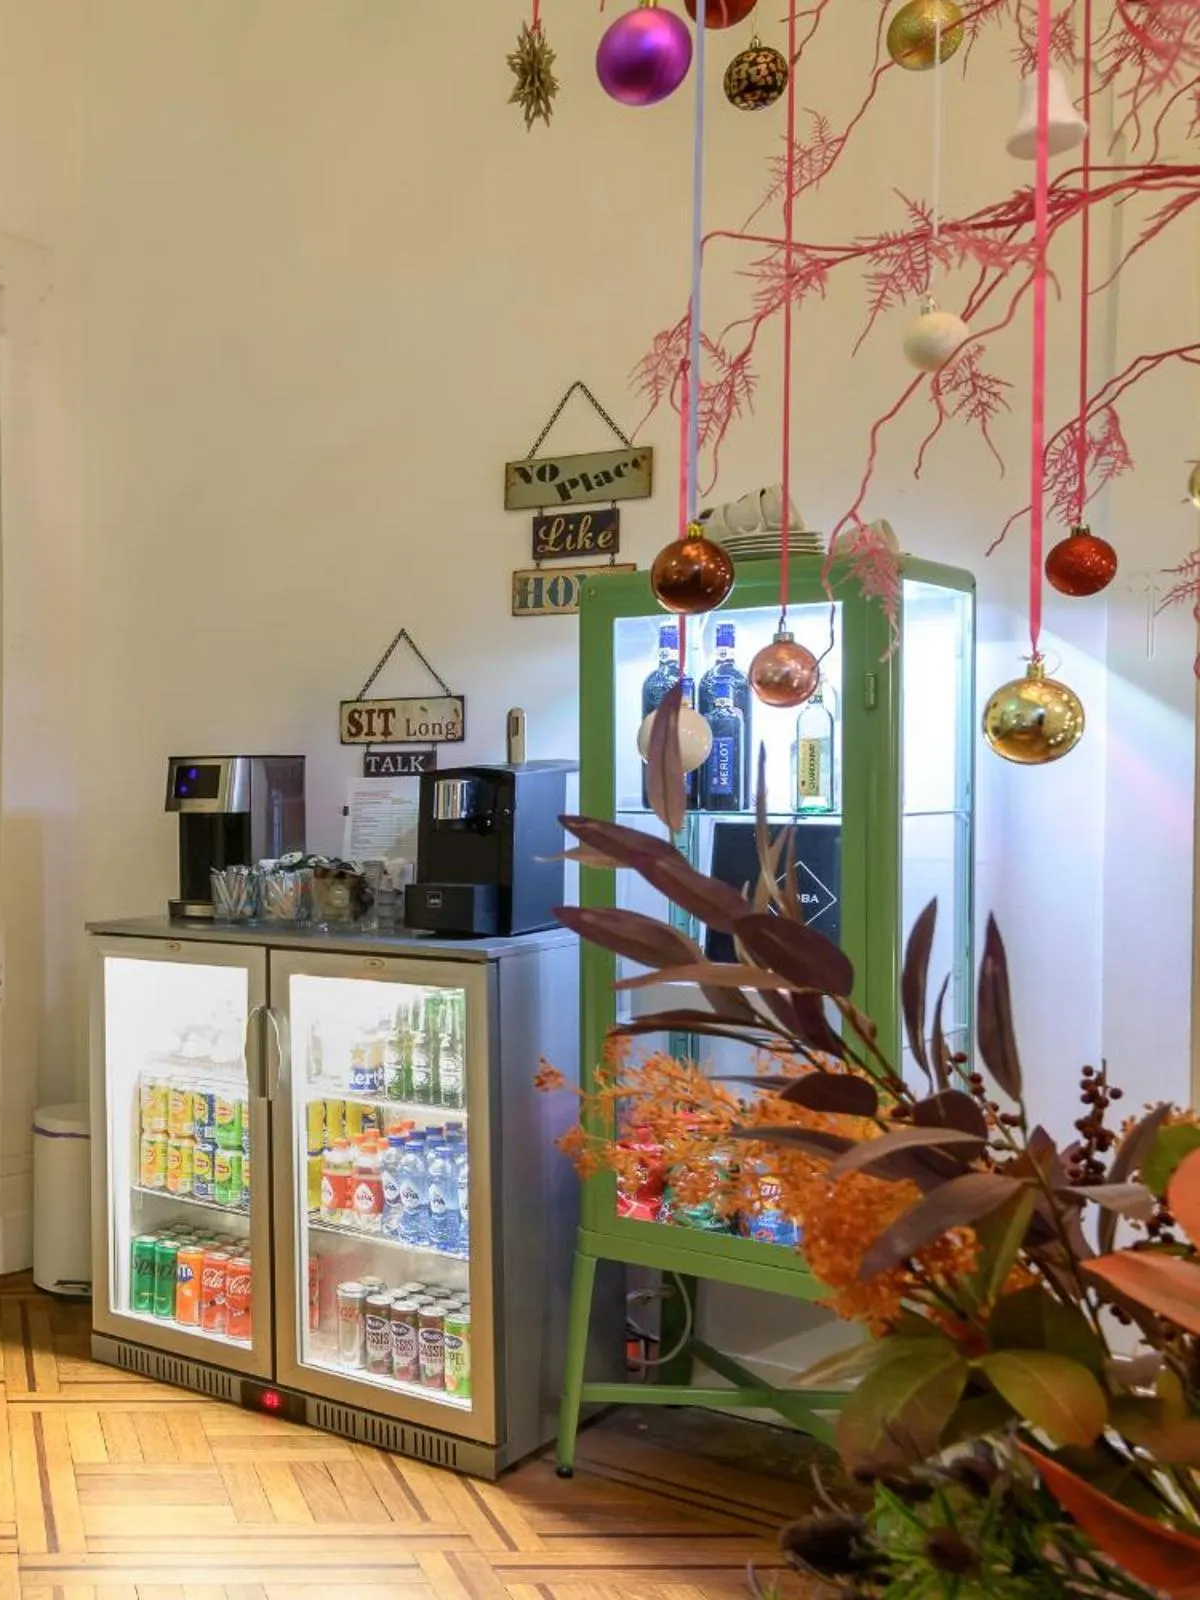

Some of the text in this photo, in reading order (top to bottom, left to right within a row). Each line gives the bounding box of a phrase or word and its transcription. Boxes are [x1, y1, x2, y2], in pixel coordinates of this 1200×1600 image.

[515, 463, 560, 485] NO
[554, 454, 649, 502] Place
[536, 514, 613, 552] Like
[516, 575, 587, 609] HO
[347, 708, 456, 741] SIT Long
[366, 755, 425, 773] TALK
[719, 742, 729, 785] MERLOT
